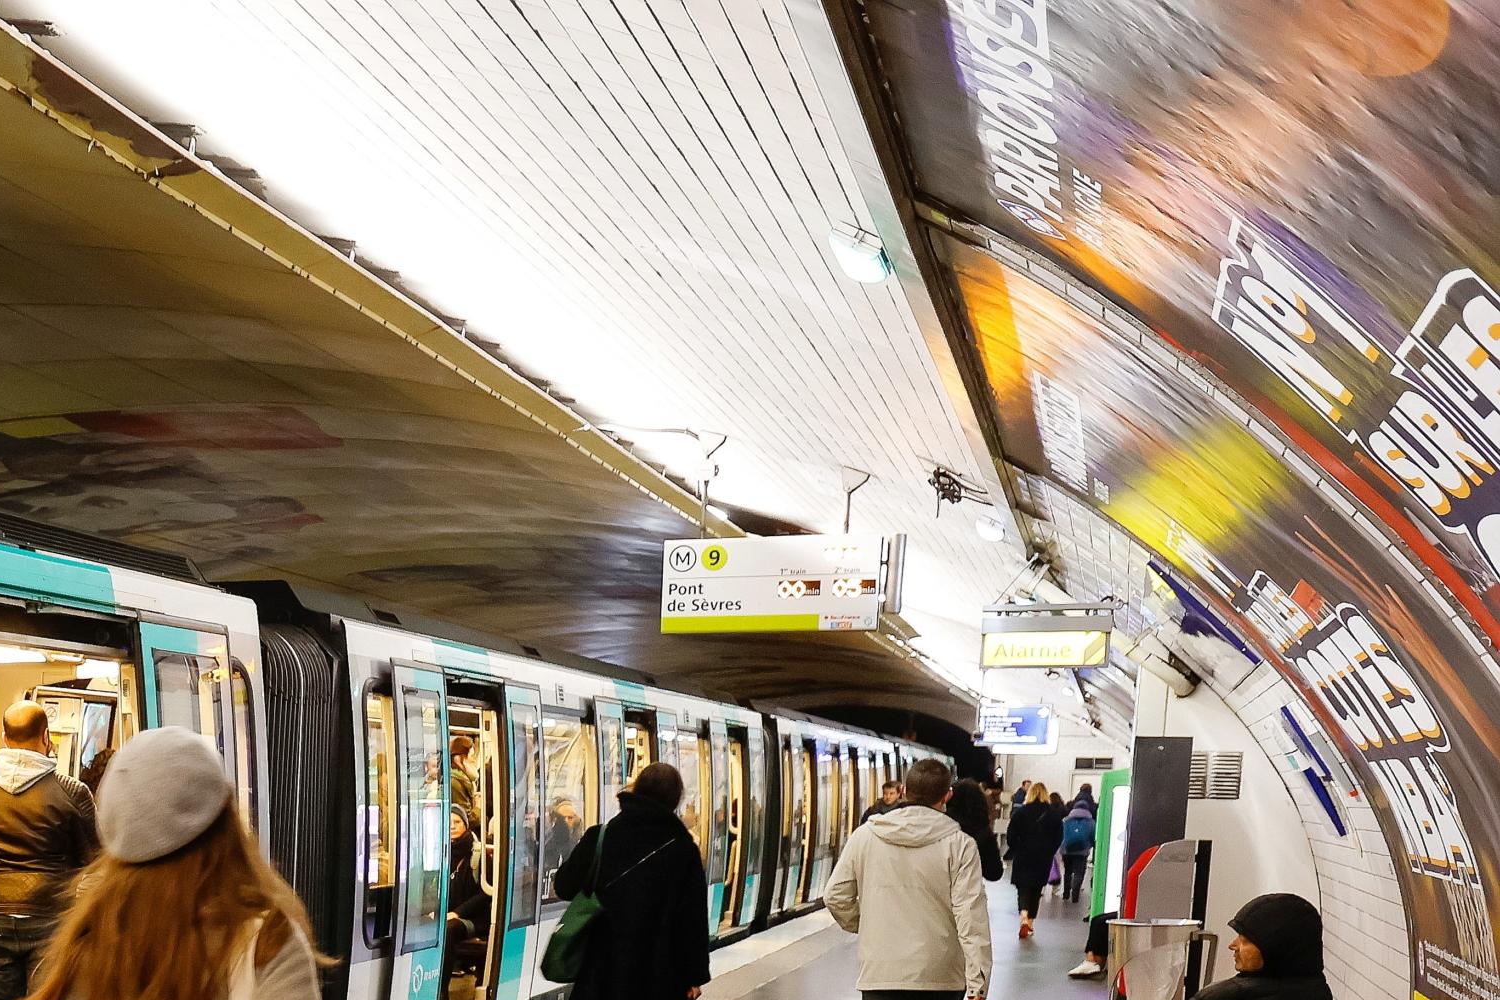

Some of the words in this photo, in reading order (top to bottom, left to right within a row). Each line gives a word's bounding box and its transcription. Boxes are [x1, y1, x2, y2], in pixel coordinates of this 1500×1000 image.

[966, 22, 1064, 224] PARIONS
[1072, 167, 1102, 222] LIGNE
[1368, 390, 1495, 516] SUR
[708, 549, 721, 566] 9
[667, 599, 688, 612] de
[691, 597, 742, 612] Sèvres
[668, 583, 704, 597] Pont
[993, 642, 1072, 659] Alarme
[1295, 615, 1443, 751] COTES
